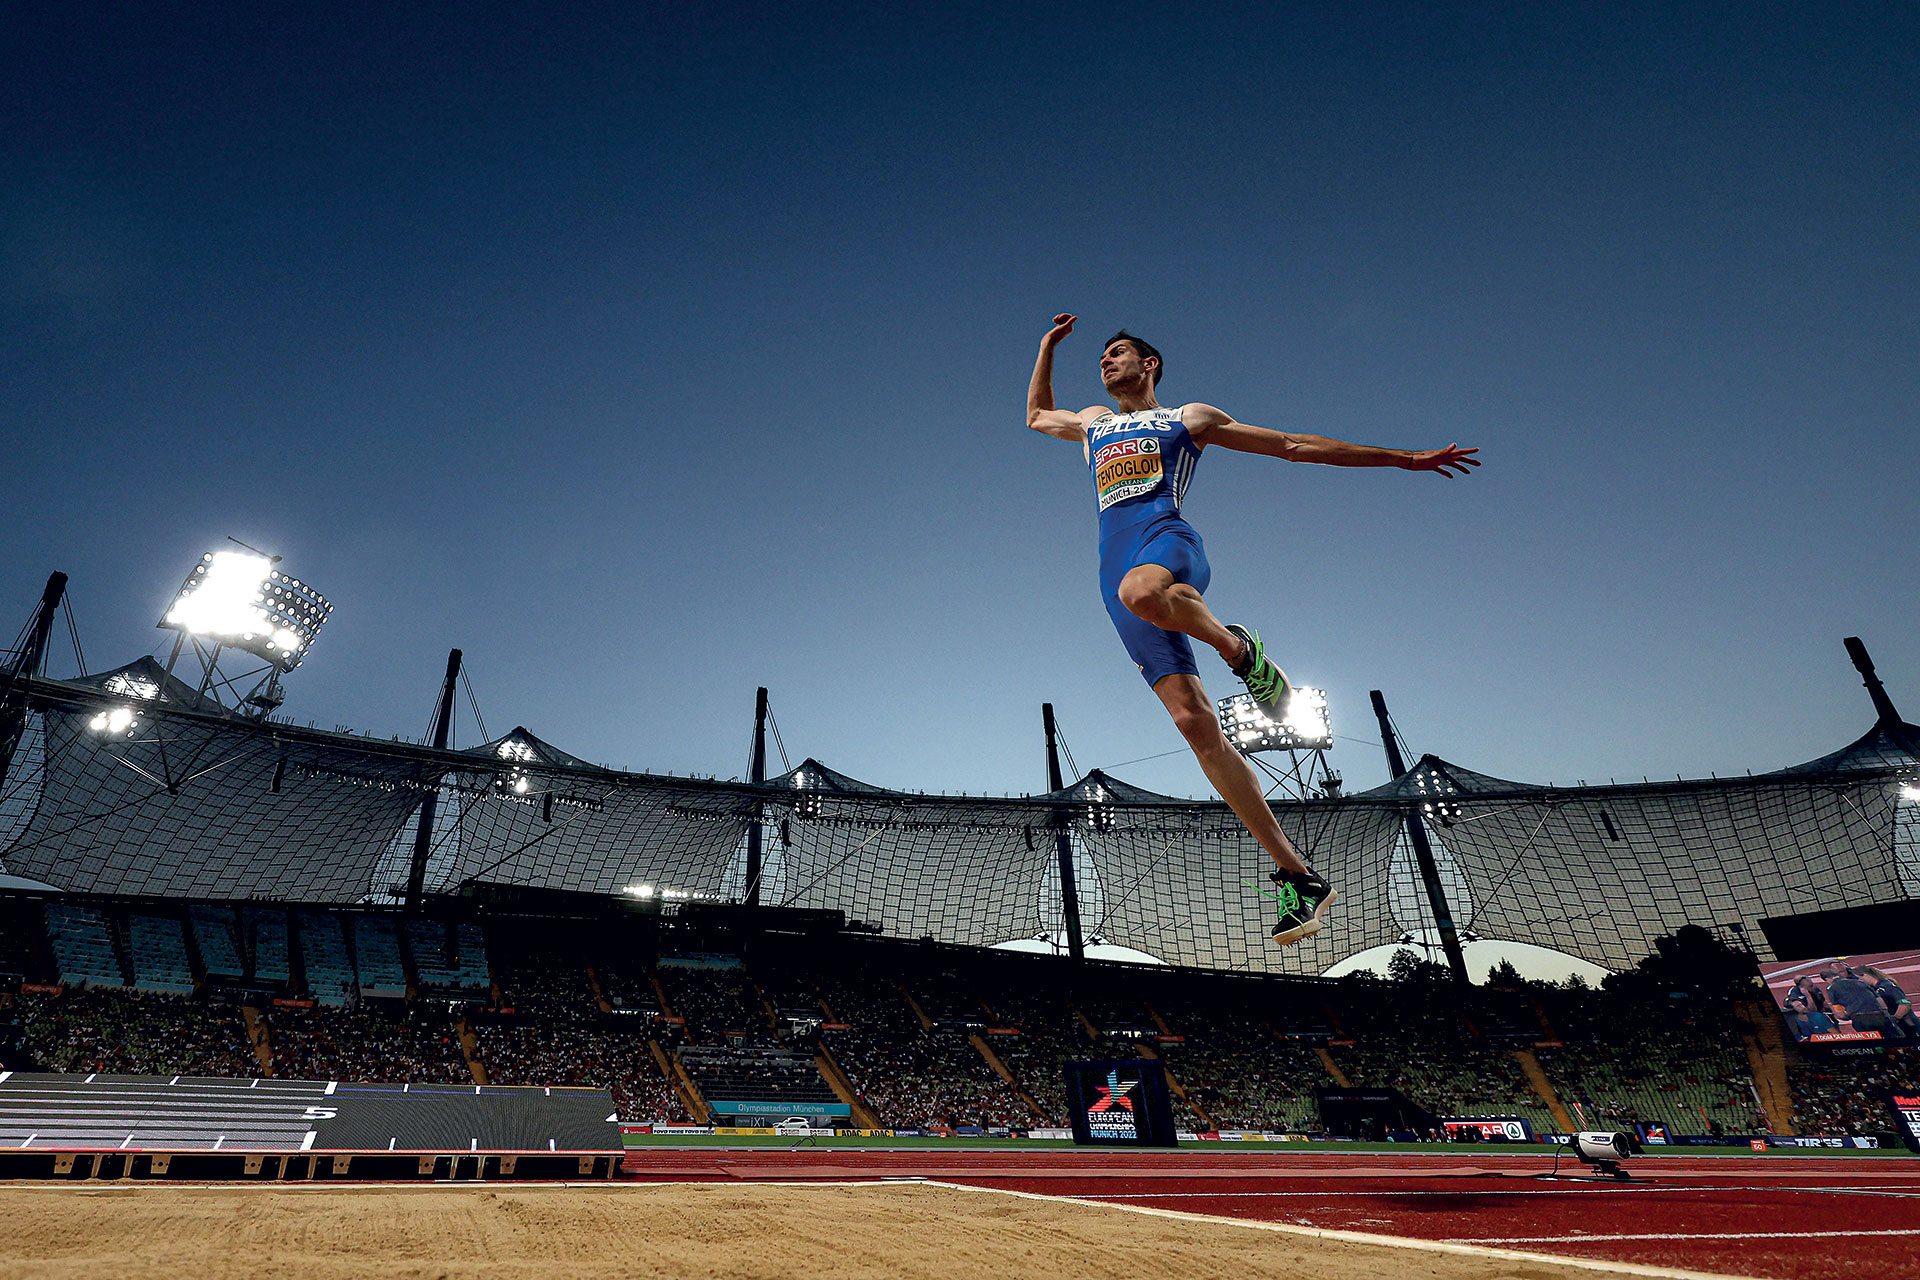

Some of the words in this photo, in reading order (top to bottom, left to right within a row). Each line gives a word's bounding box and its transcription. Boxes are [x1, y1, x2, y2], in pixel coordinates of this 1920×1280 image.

[1091, 419, 1172, 444] HELLAS
[1095, 442, 1137, 464] SPAR
[1097, 459, 1159, 488] TENTOGLOU
[1101, 487, 1130, 508] MUNICH
[1832, 1047, 1874, 1056] EUROPEAN
[302, 1107, 338, 1120] 5
[738, 1103, 791, 1113] Olympiastadion
[793, 1104, 825, 1113] München
[1088, 1112, 1135, 1123] EUROPEAN
[842, 1129, 862, 1137] ADAC
[870, 1129, 890, 1137] ADAC
[1091, 1130, 1118, 1138] MUNICH
[1120, 1130, 1138, 1138] 2022
